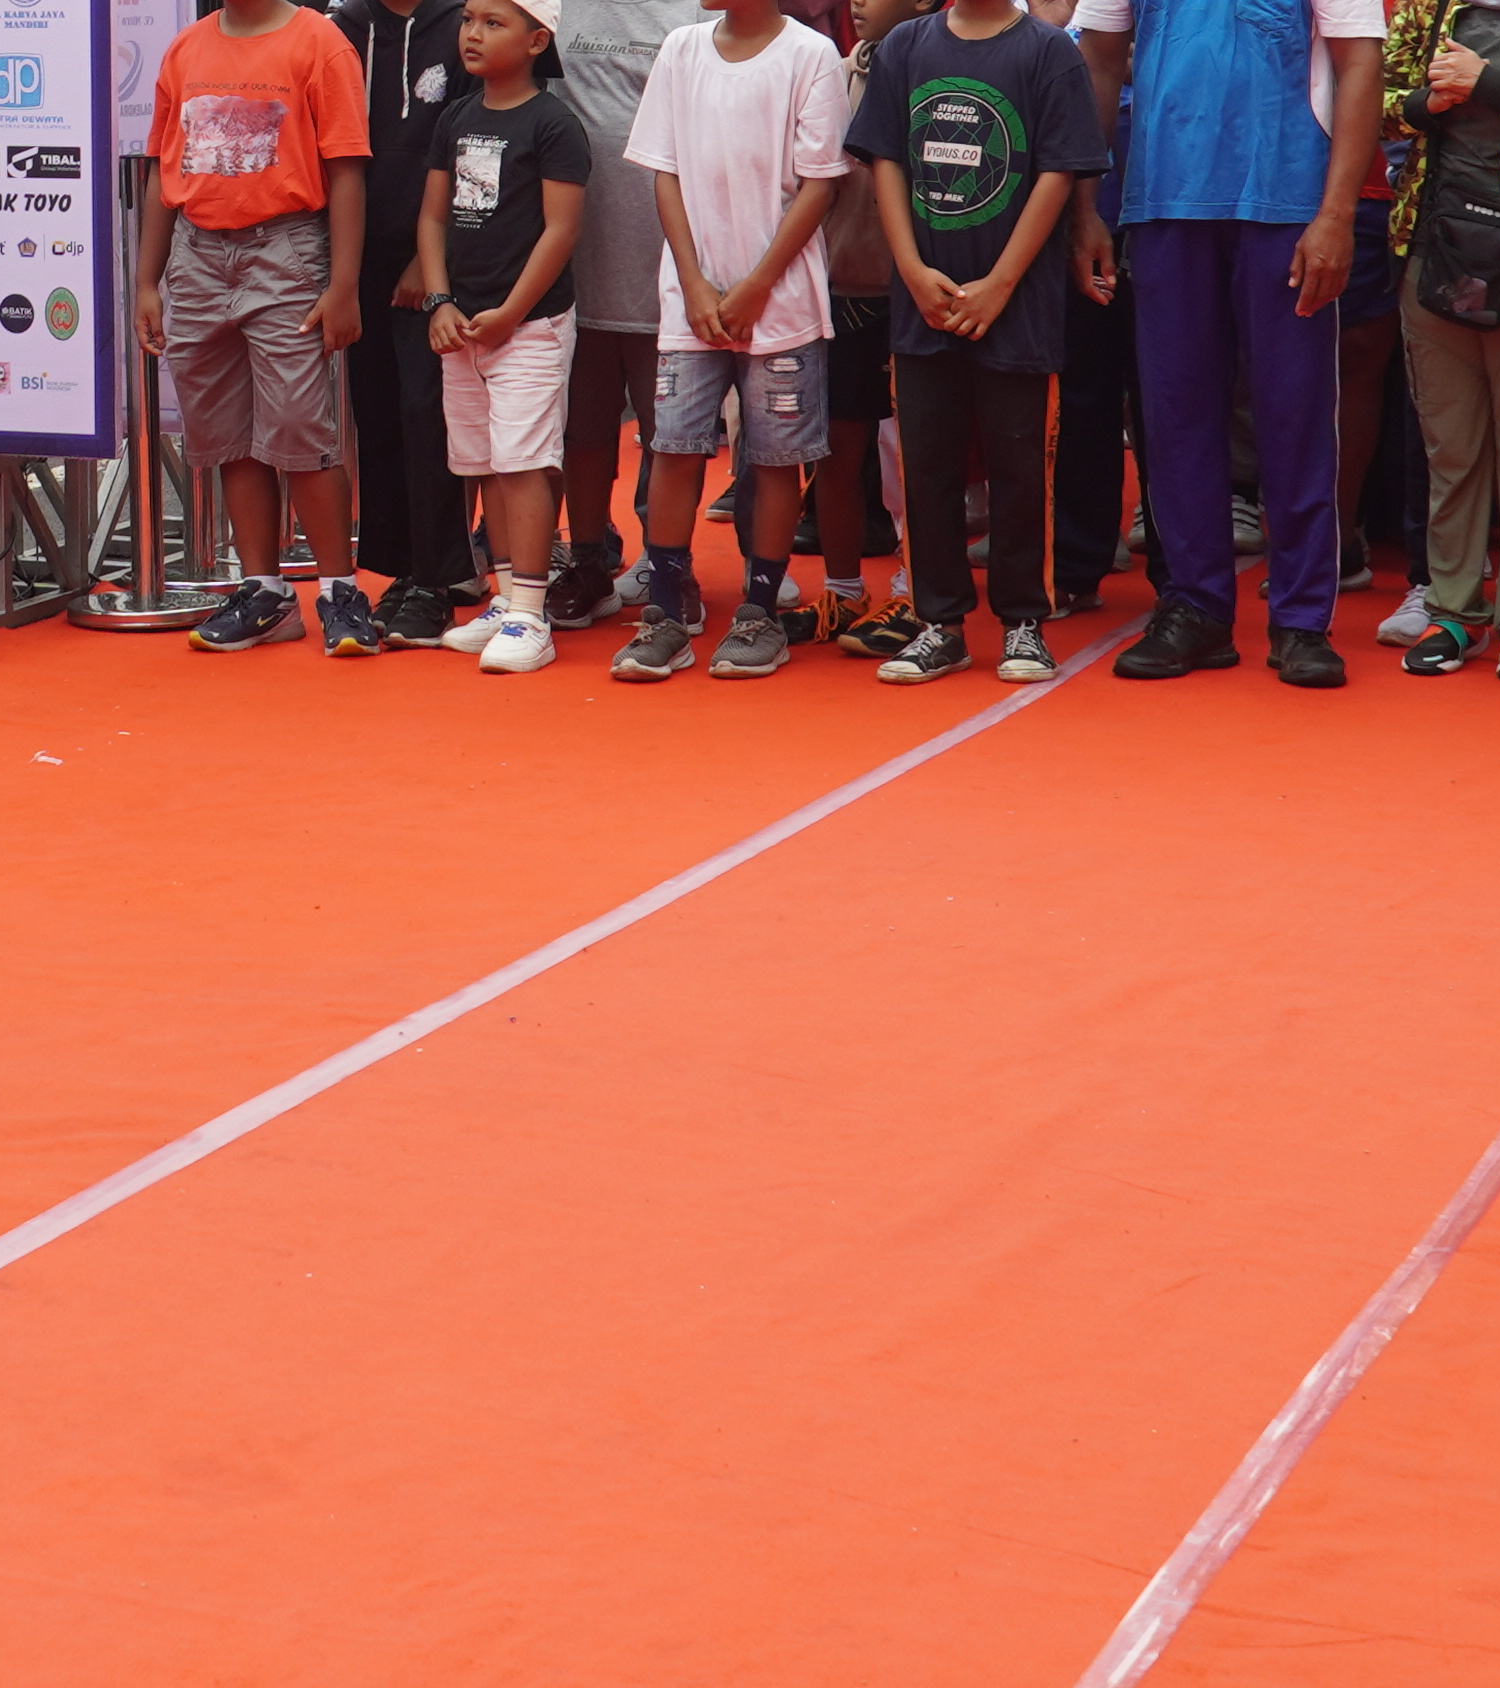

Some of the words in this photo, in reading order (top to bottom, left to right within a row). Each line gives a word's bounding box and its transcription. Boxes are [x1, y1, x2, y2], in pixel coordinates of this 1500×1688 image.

[4, 11, 38, 19] KARYA
[40, 11, 65, 19] JAYA
[4, 21, 48, 29] MANDIRI
[567, 33, 628, 54] division
[937, 103, 976, 115] STEPPED
[22, 115, 64, 124] DEWATA
[932, 111, 980, 124] TOGETHER
[23, 193, 72, 212] TOYO
[66, 240, 84, 257] djp
[21, 376, 44, 390] BSI
